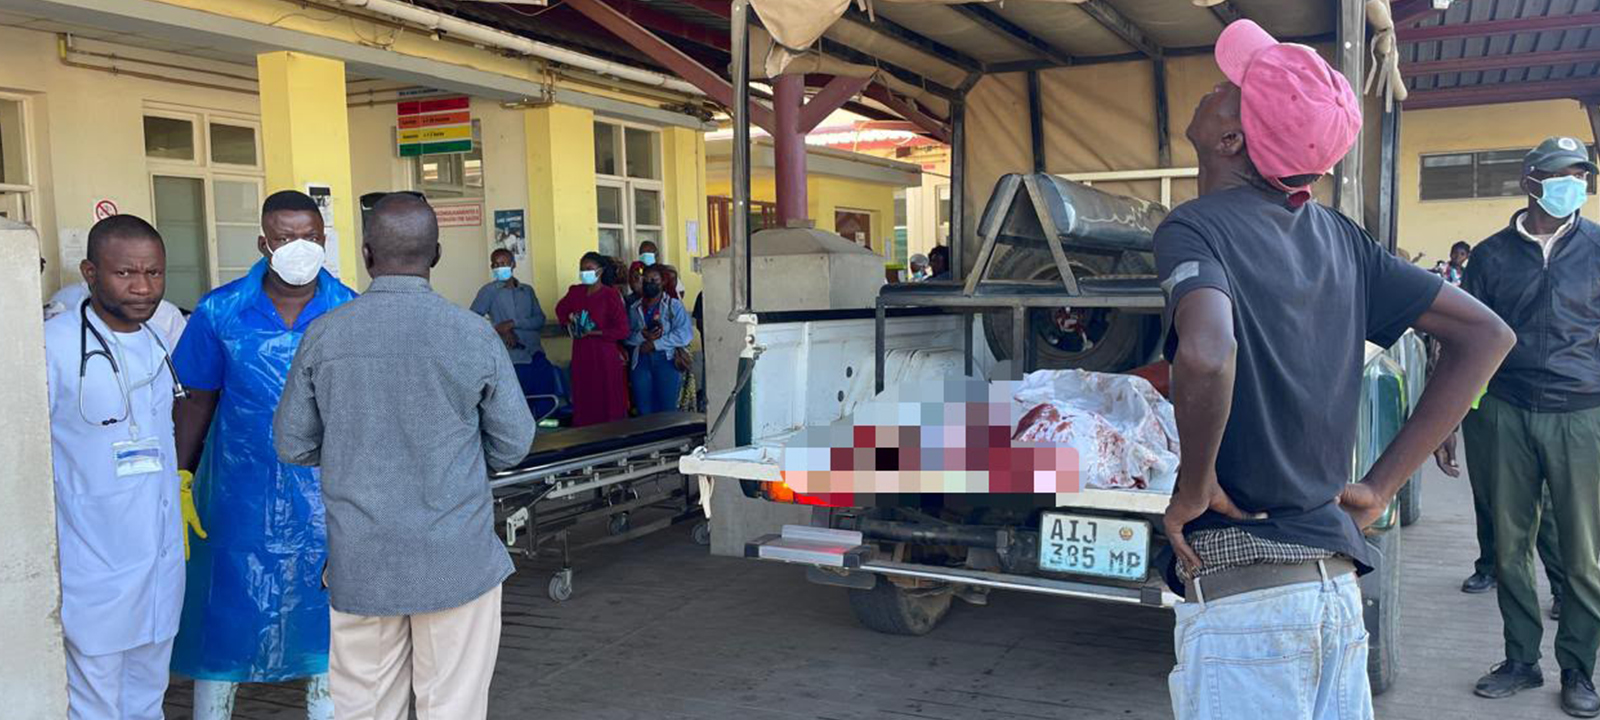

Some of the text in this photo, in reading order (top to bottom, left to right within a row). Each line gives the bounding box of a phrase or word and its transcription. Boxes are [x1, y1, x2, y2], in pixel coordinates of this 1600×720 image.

[1050, 519, 1097, 544] AIJ
[1050, 543, 1141, 574] 385 MP
